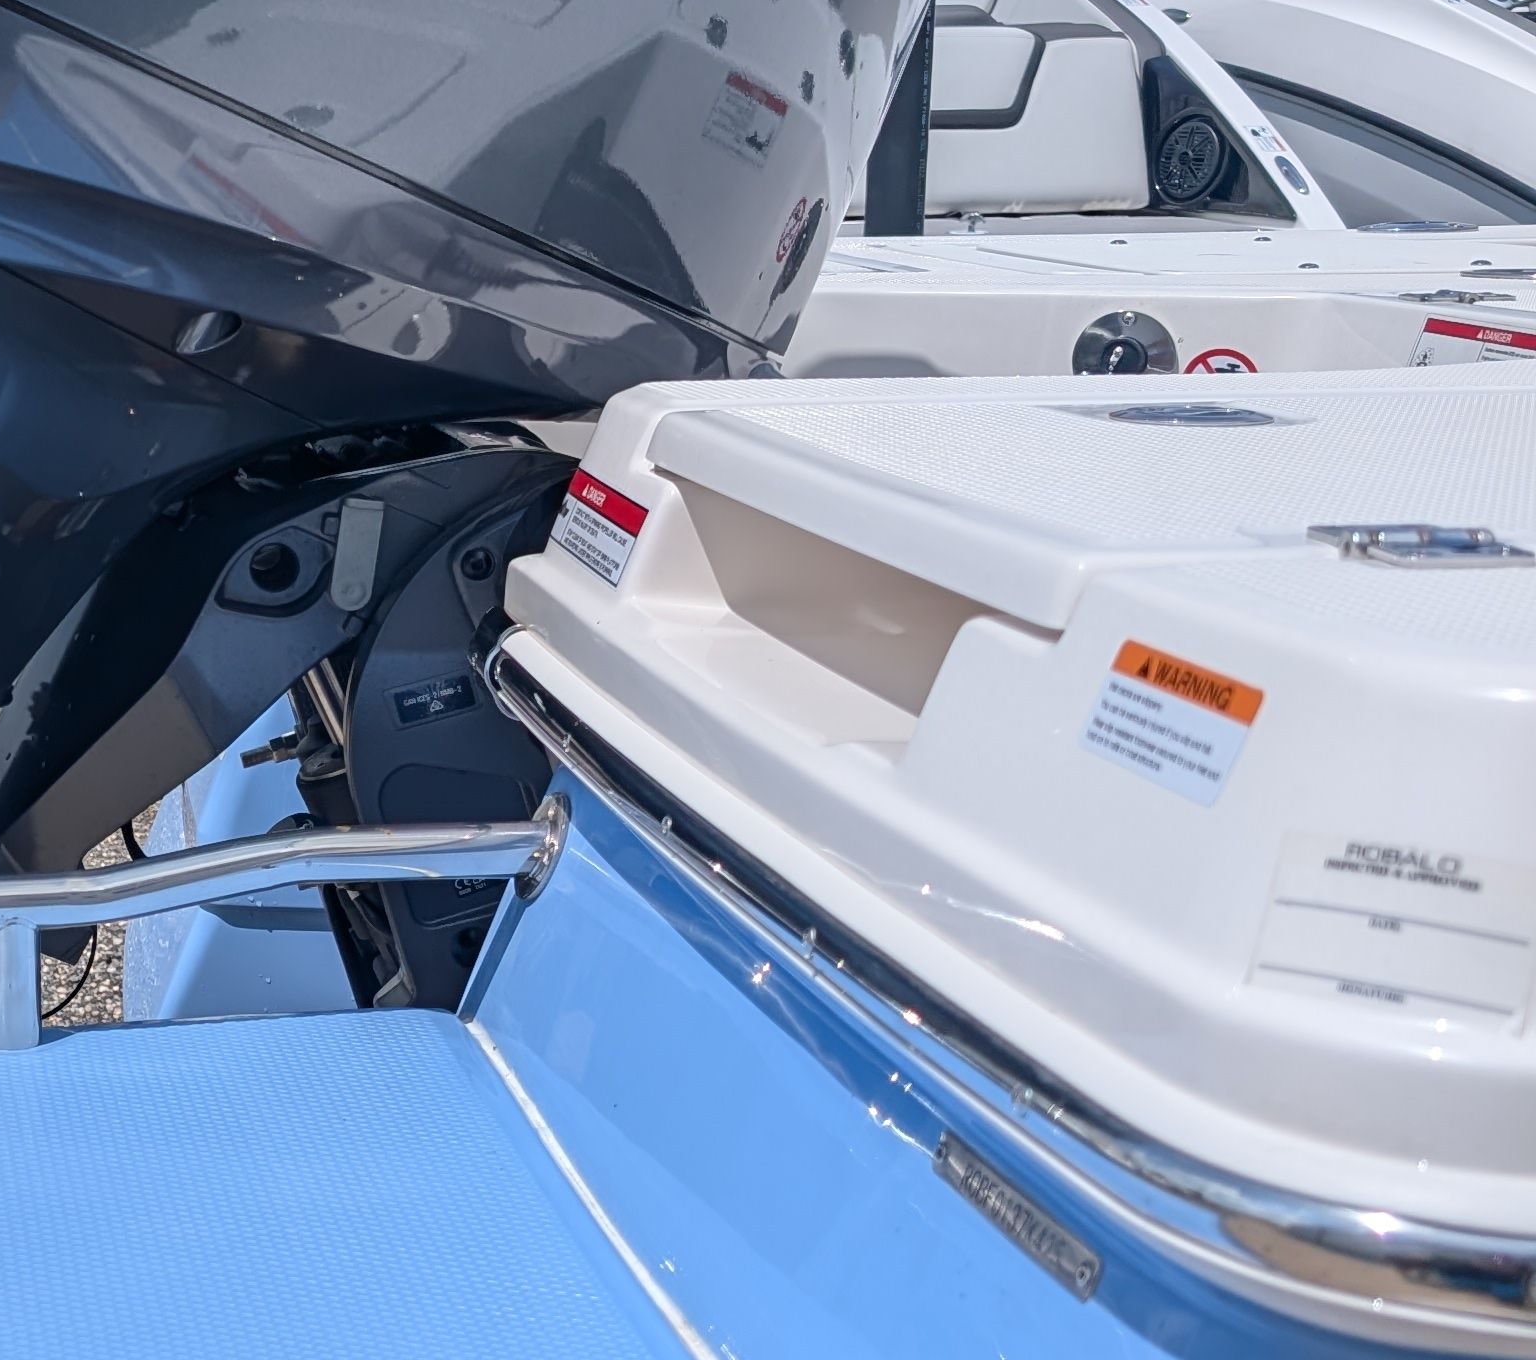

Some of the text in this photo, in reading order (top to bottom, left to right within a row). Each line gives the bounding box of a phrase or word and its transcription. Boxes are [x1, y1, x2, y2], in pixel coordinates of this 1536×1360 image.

[1484, 330, 1512, 343] DANGER
[1155, 662, 1233, 709] WARNING
[1344, 842, 1465, 875] ROBALO
